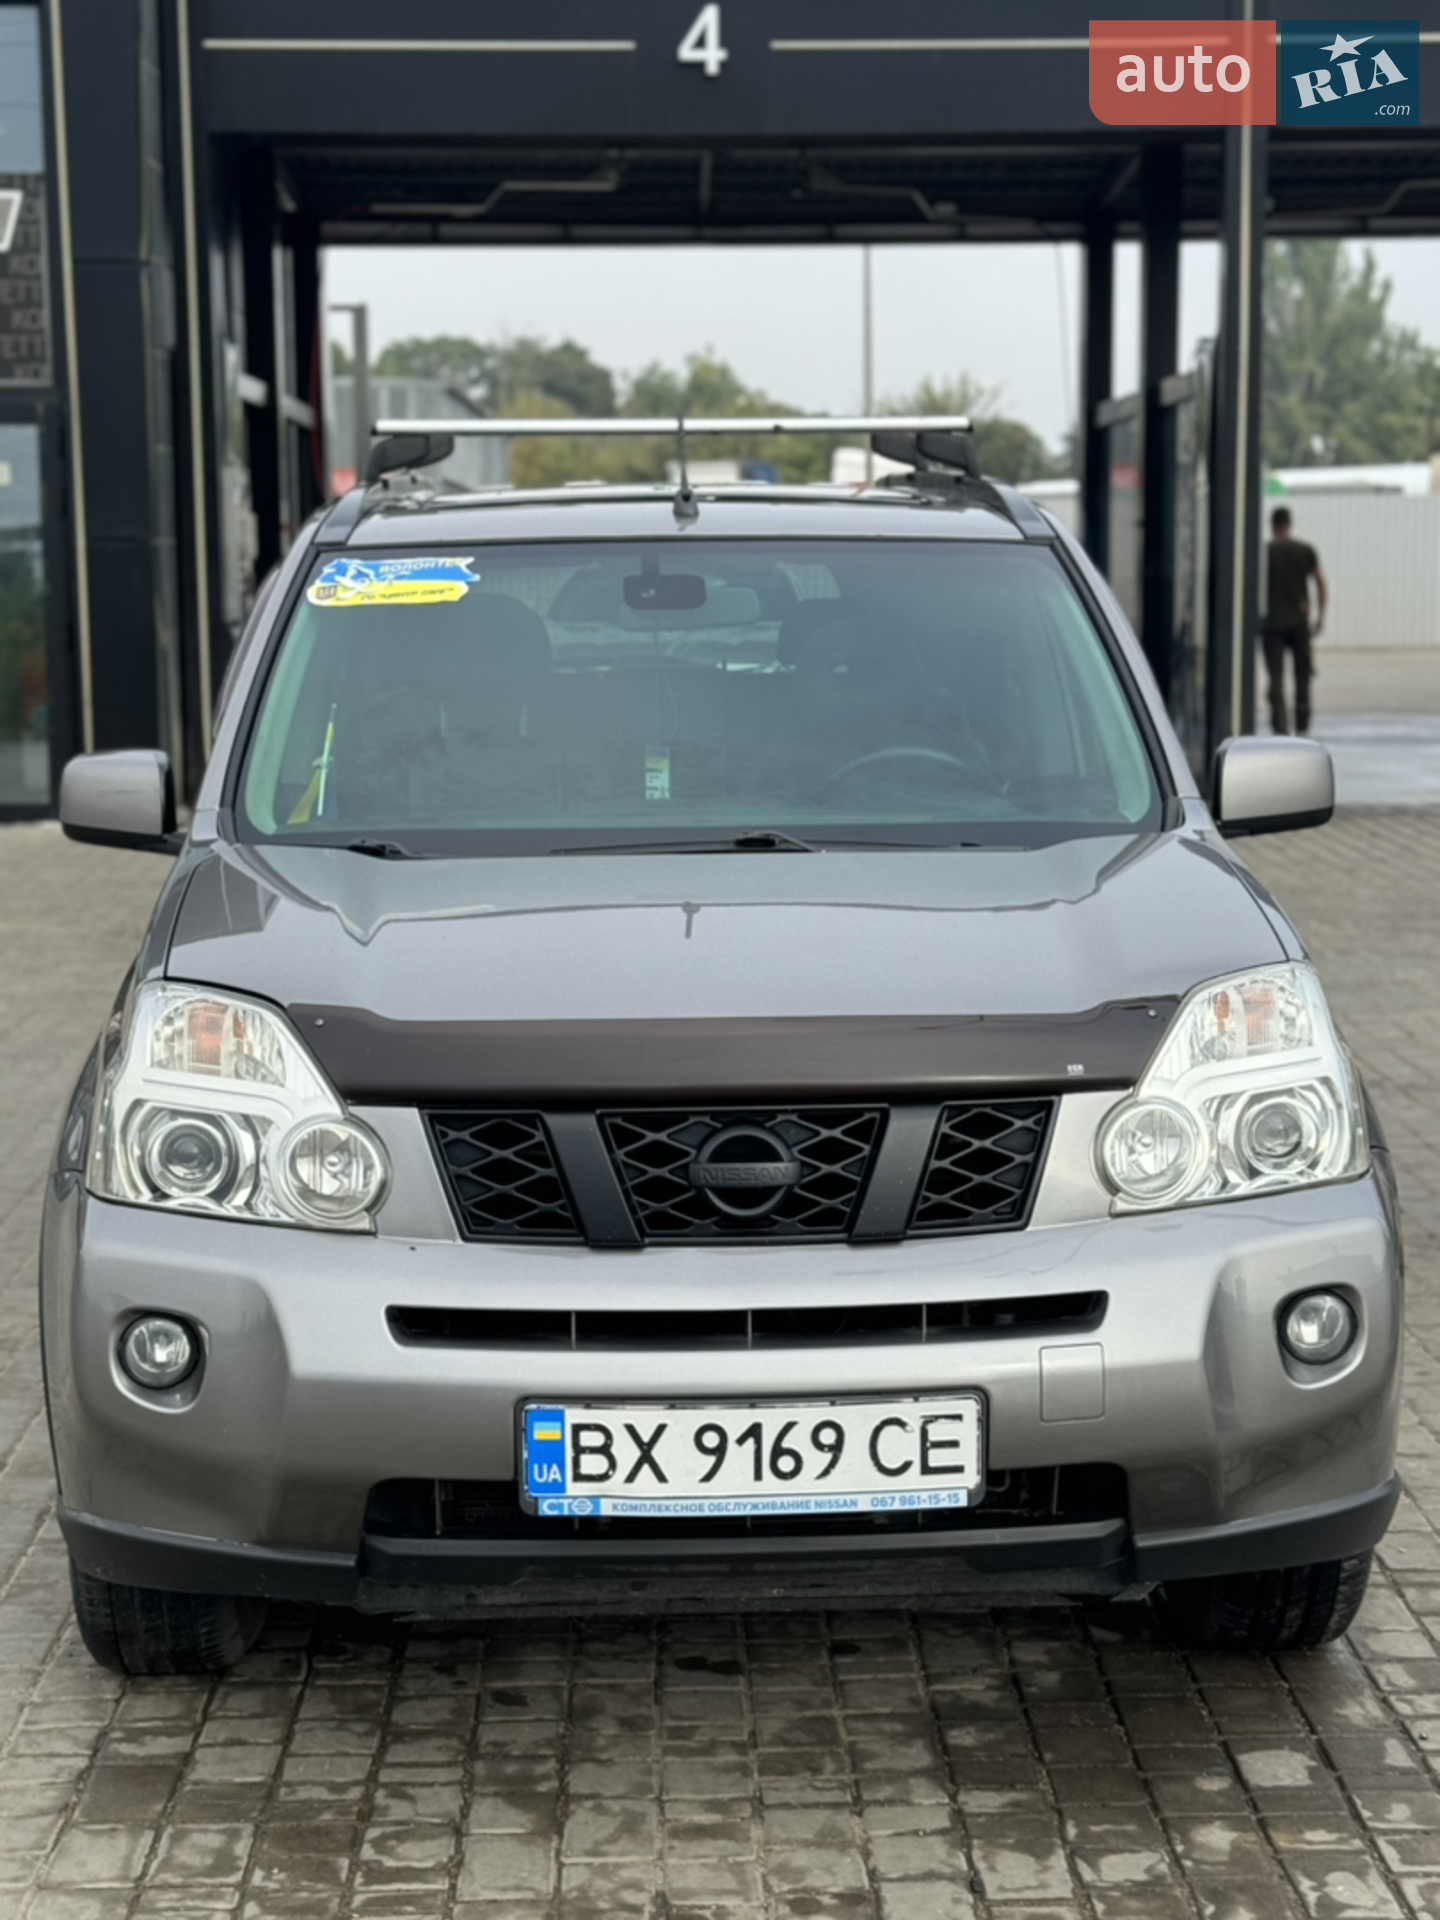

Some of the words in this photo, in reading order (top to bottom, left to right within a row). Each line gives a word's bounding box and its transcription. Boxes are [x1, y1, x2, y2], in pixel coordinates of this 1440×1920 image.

[677, 3, 729, 77] 4
[701, 1166, 791, 1185] NISSAN
[570, 1422, 669, 1484] BX
[693, 1419, 846, 1483] 9169
[868, 1414, 965, 1477] CE
[533, 1464, 562, 1483] UA
[611, 1501, 705, 1513] КОМПЛЕКСНОЕ
[708, 1499, 812, 1513] ОБСЛУЖИВАНИЕ
[814, 1498, 859, 1510] NISSAN
[870, 1495, 896, 1508] 067
[899, 1492, 961, 1507] 961-15-15
